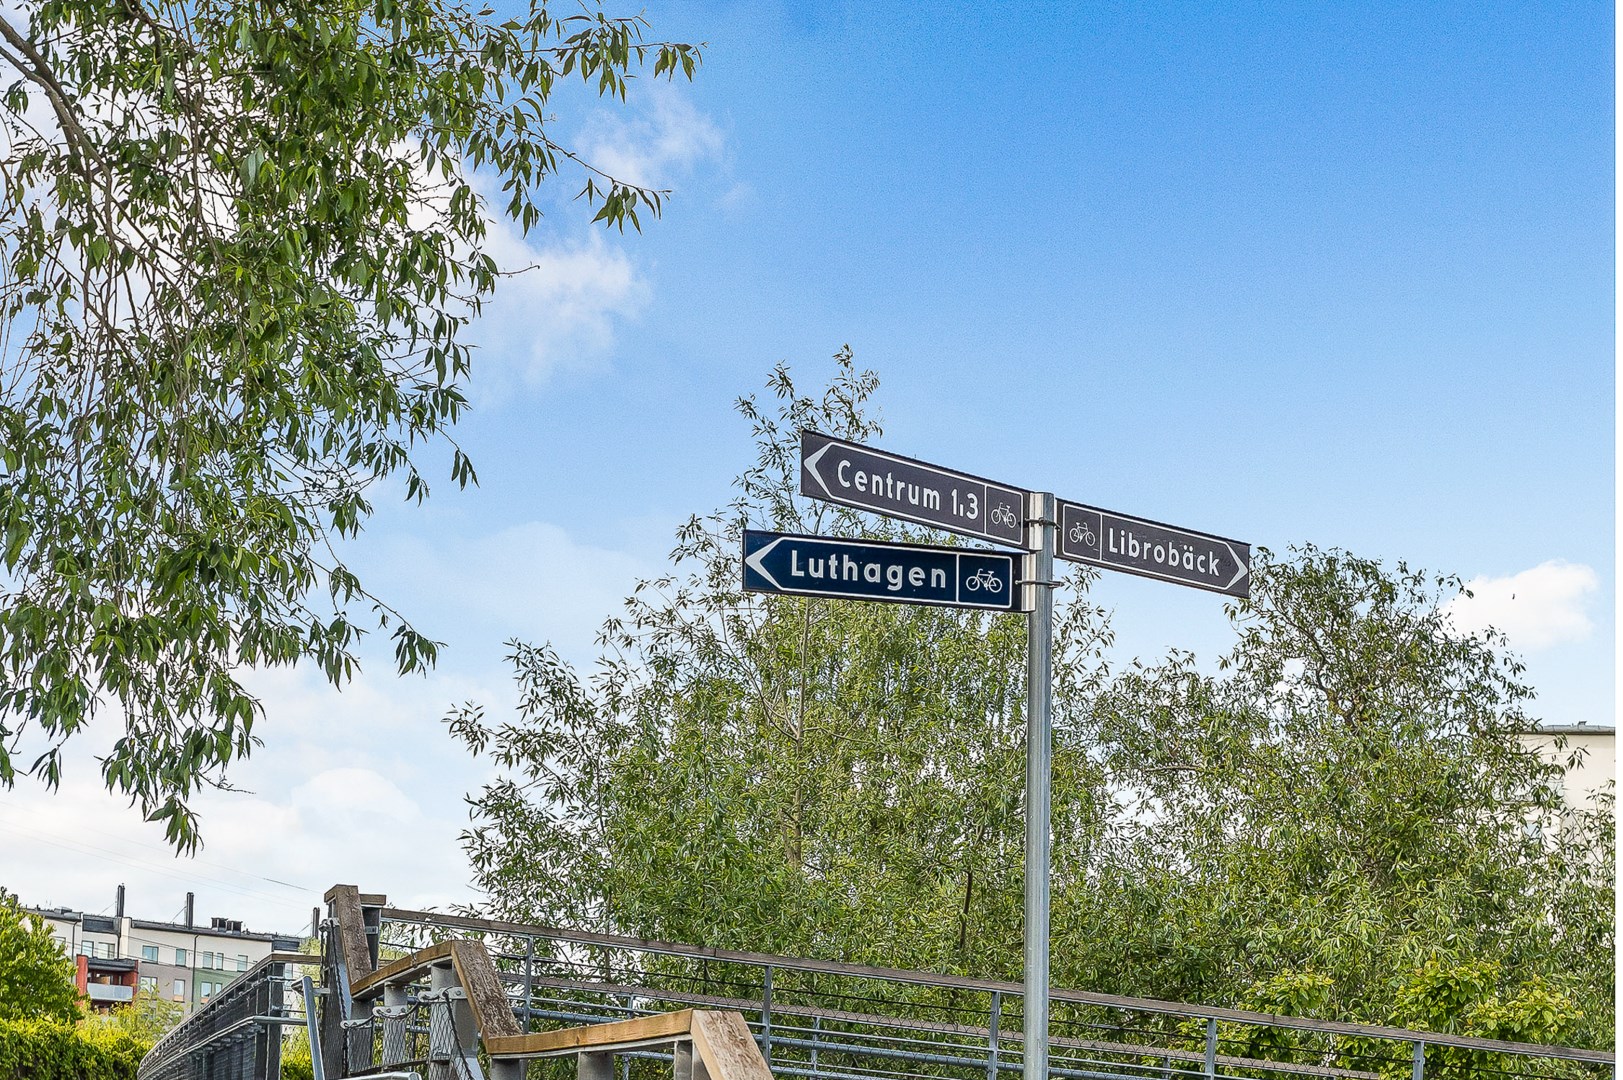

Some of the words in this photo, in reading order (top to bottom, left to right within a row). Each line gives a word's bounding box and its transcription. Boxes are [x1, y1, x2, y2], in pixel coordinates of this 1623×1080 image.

[838, 460, 940, 511] Centrum
[791, 550, 946, 590] Luthagen
[1109, 528, 1220, 577] Librobäck
